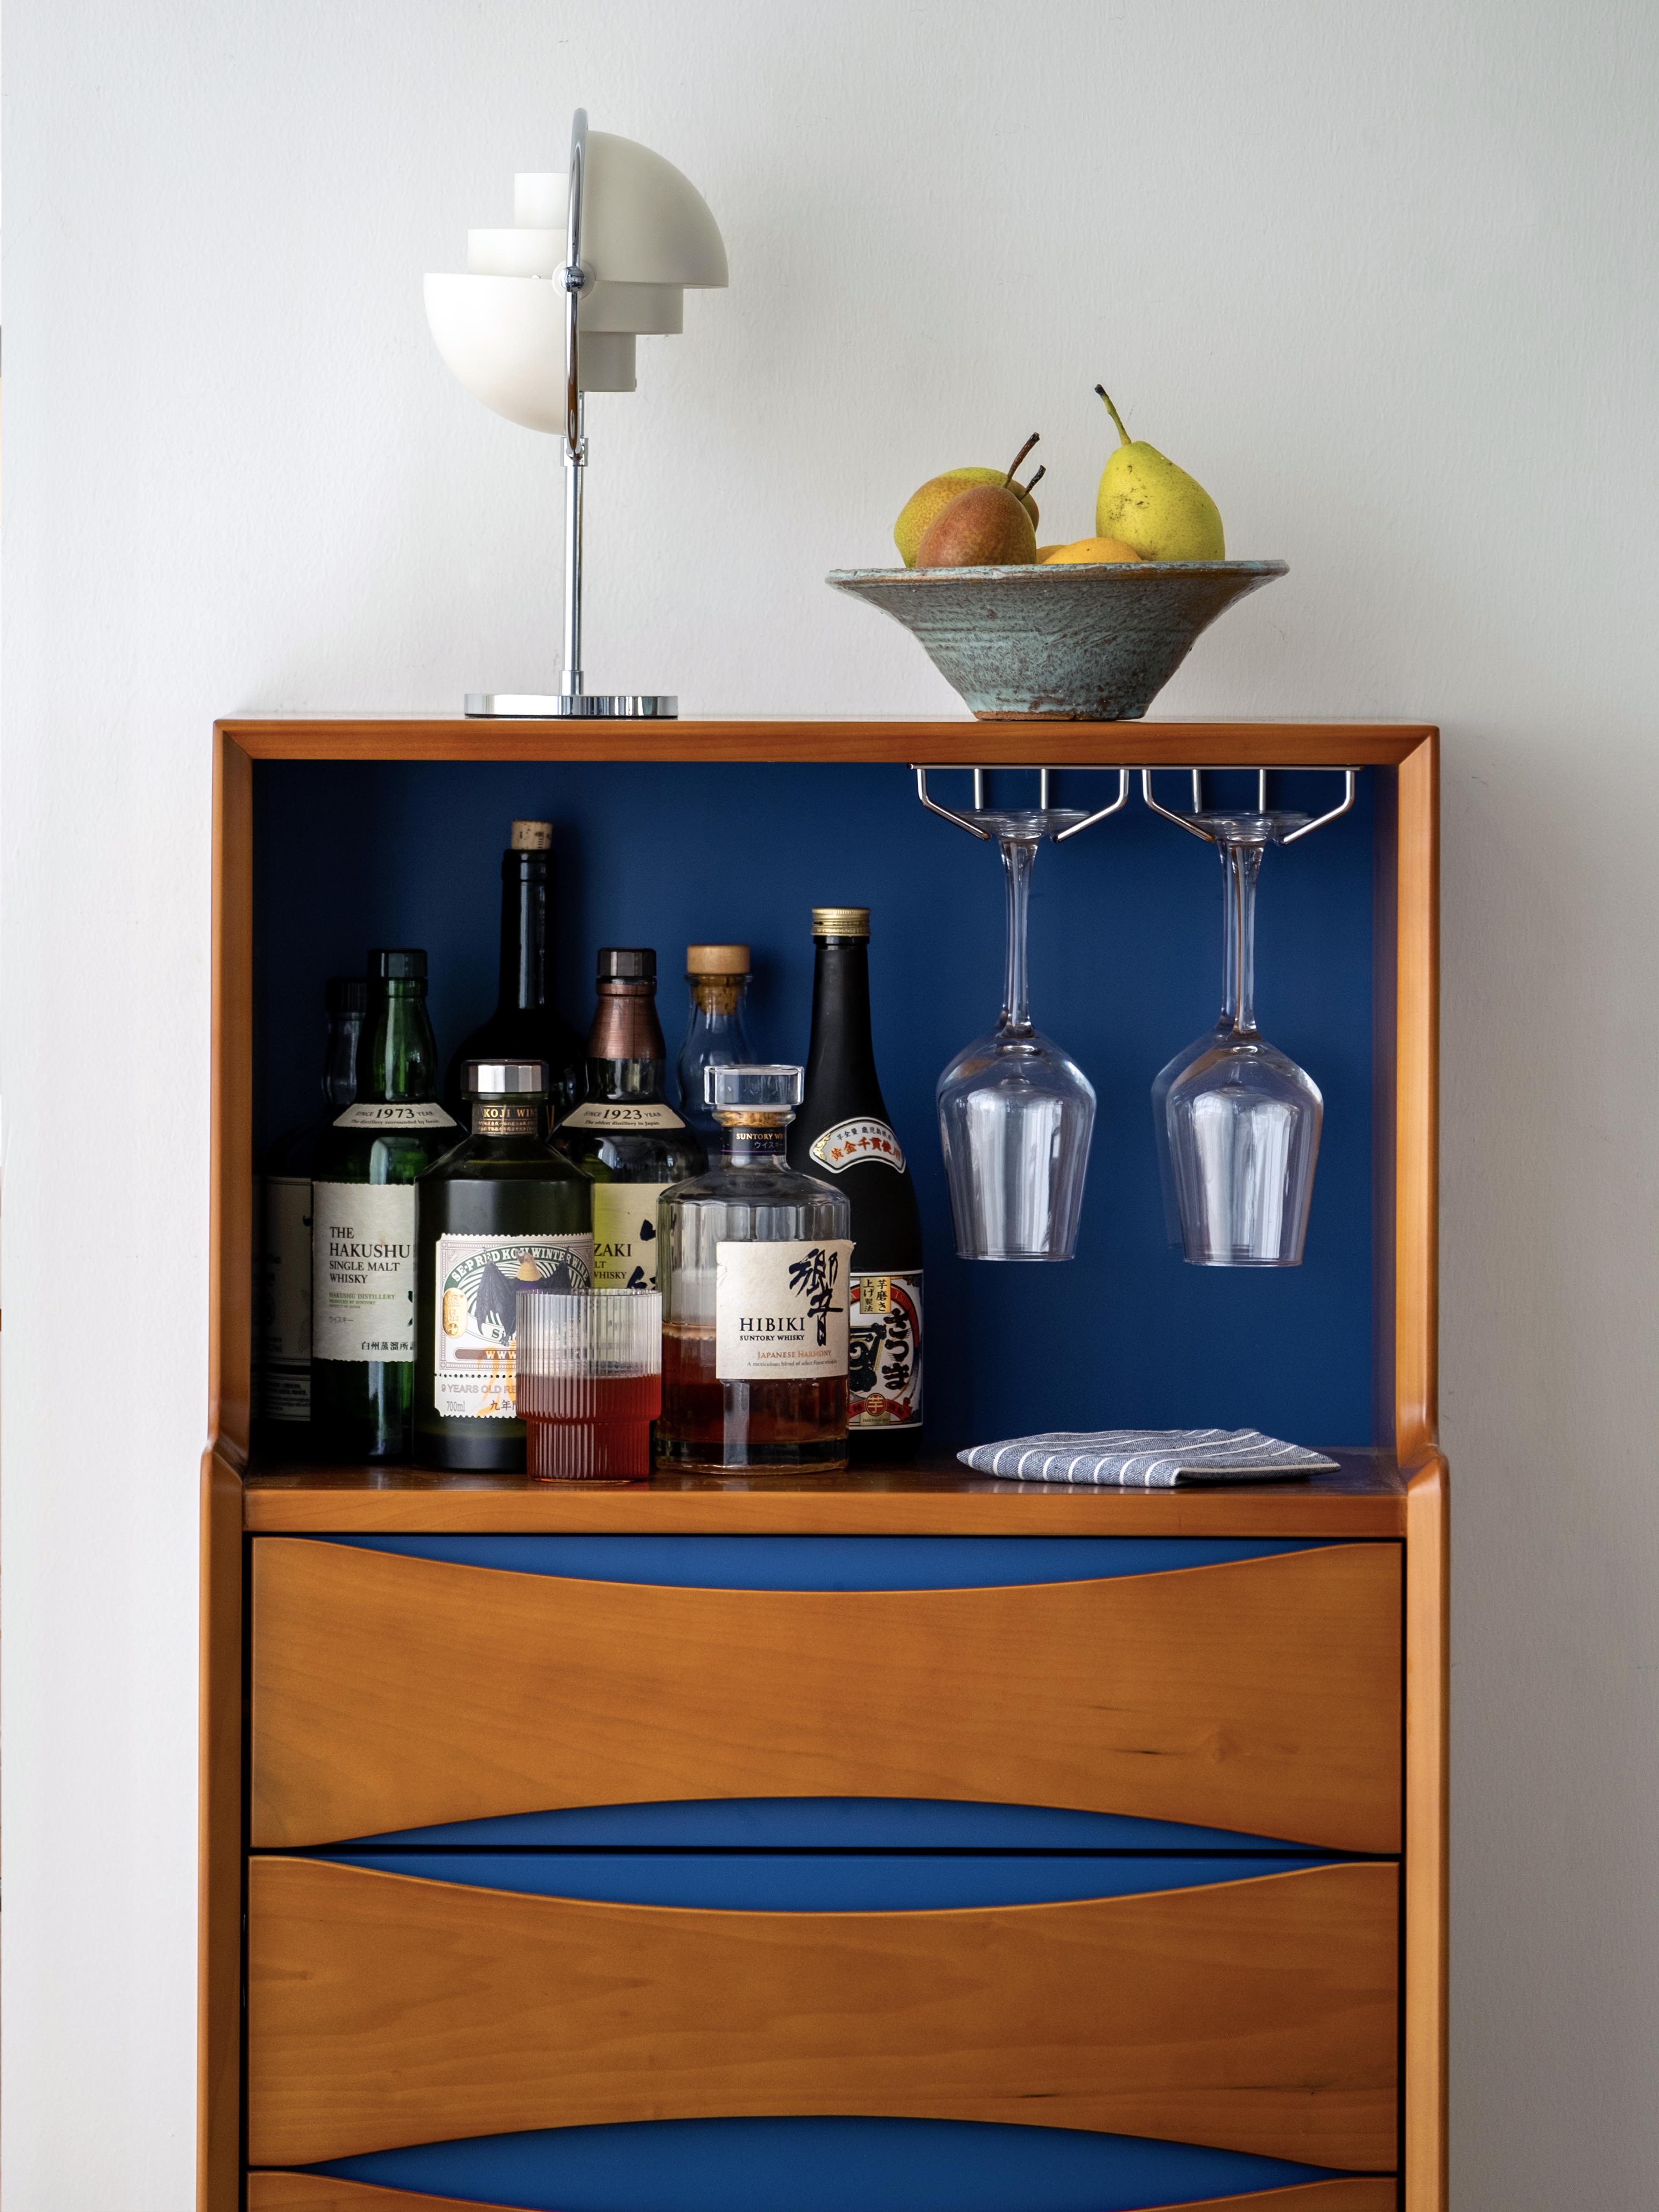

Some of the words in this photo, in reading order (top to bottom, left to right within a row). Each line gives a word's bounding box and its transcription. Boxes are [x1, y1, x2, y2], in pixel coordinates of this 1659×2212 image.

[376, 1108, 415, 1119] 1973
[484, 1109, 511, 1118] KOJI
[603, 1109, 642, 1120] 1923
[330, 1227, 354, 1239] THE
[330, 1243, 411, 1258] HAKUSHU
[329, 1262, 364, 1271] SINGLE
[368, 1263, 400, 1271] MALT
[531, 1247, 572, 1264] WINTER
[570, 1255, 590, 1281] WINE
[330, 1274, 368, 1283] WHISKY
[789, 1248, 844, 1347] 響
[863, 1279, 874, 1312] 上げ製法
[876, 1279, 888, 1312] 芋磨き
[739, 1318, 805, 1331] HIBIKI
[882, 1307, 910, 1390] さつま
[441, 1384, 446, 1392] 9
[447, 1401, 465, 1411] 700ml
[868, 1396, 883, 1413] 芋
